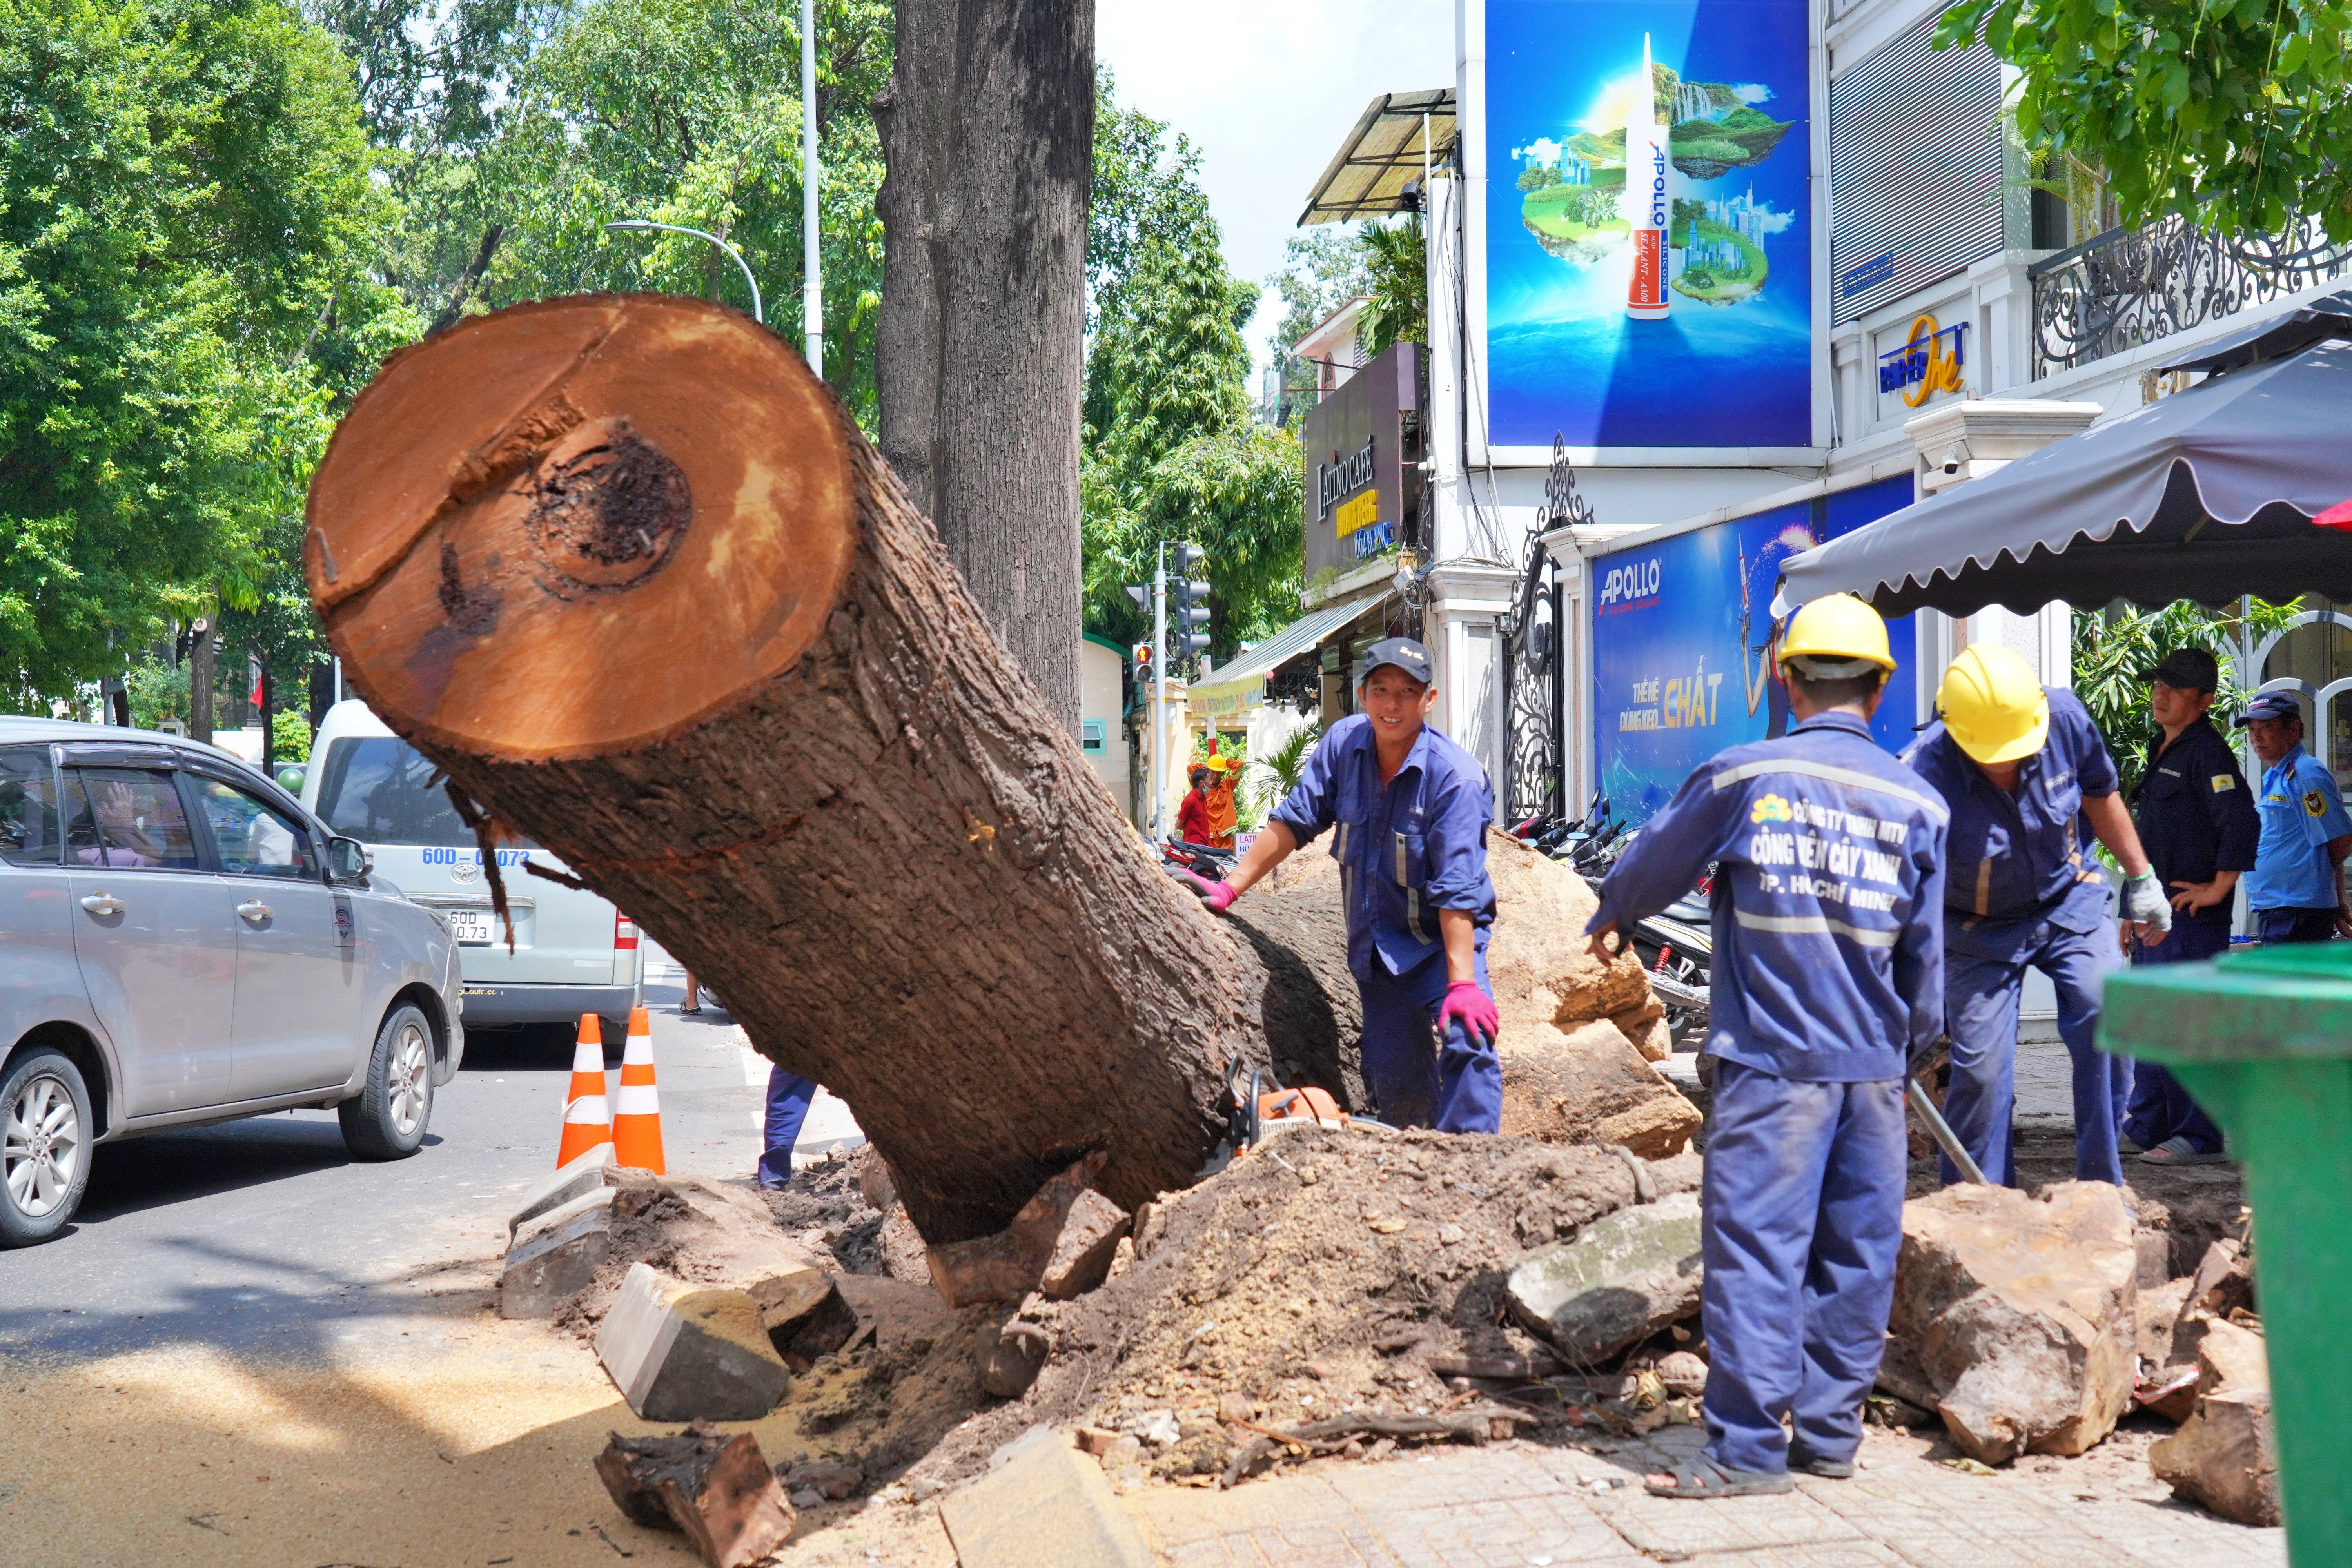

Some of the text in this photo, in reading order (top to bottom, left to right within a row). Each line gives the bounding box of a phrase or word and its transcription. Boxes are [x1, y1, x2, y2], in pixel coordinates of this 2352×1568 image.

[1649, 140, 1665, 226] APOLLO
[1640, 232, 1648, 275] SEALANT
[1640, 282, 1648, 302] A300
[1880, 352, 1930, 394] PAPER
[1349, 434, 1374, 491] CAFÉ
[1598, 558, 1660, 617] APOLLO
[1664, 655, 1724, 729] CHẤT
[1793, 798, 1826, 828] CÔNG
[1826, 809, 1845, 831] TY
[423, 848, 456, 865] 60D
[475, 849, 530, 867] 00.73
[1751, 825, 1795, 865] CÔNG
[1828, 836, 1862, 878] CÂY
[1861, 849, 1902, 886] XANH
[451, 912, 477, 924] 60D
[1849, 887, 1898, 912] MINH
